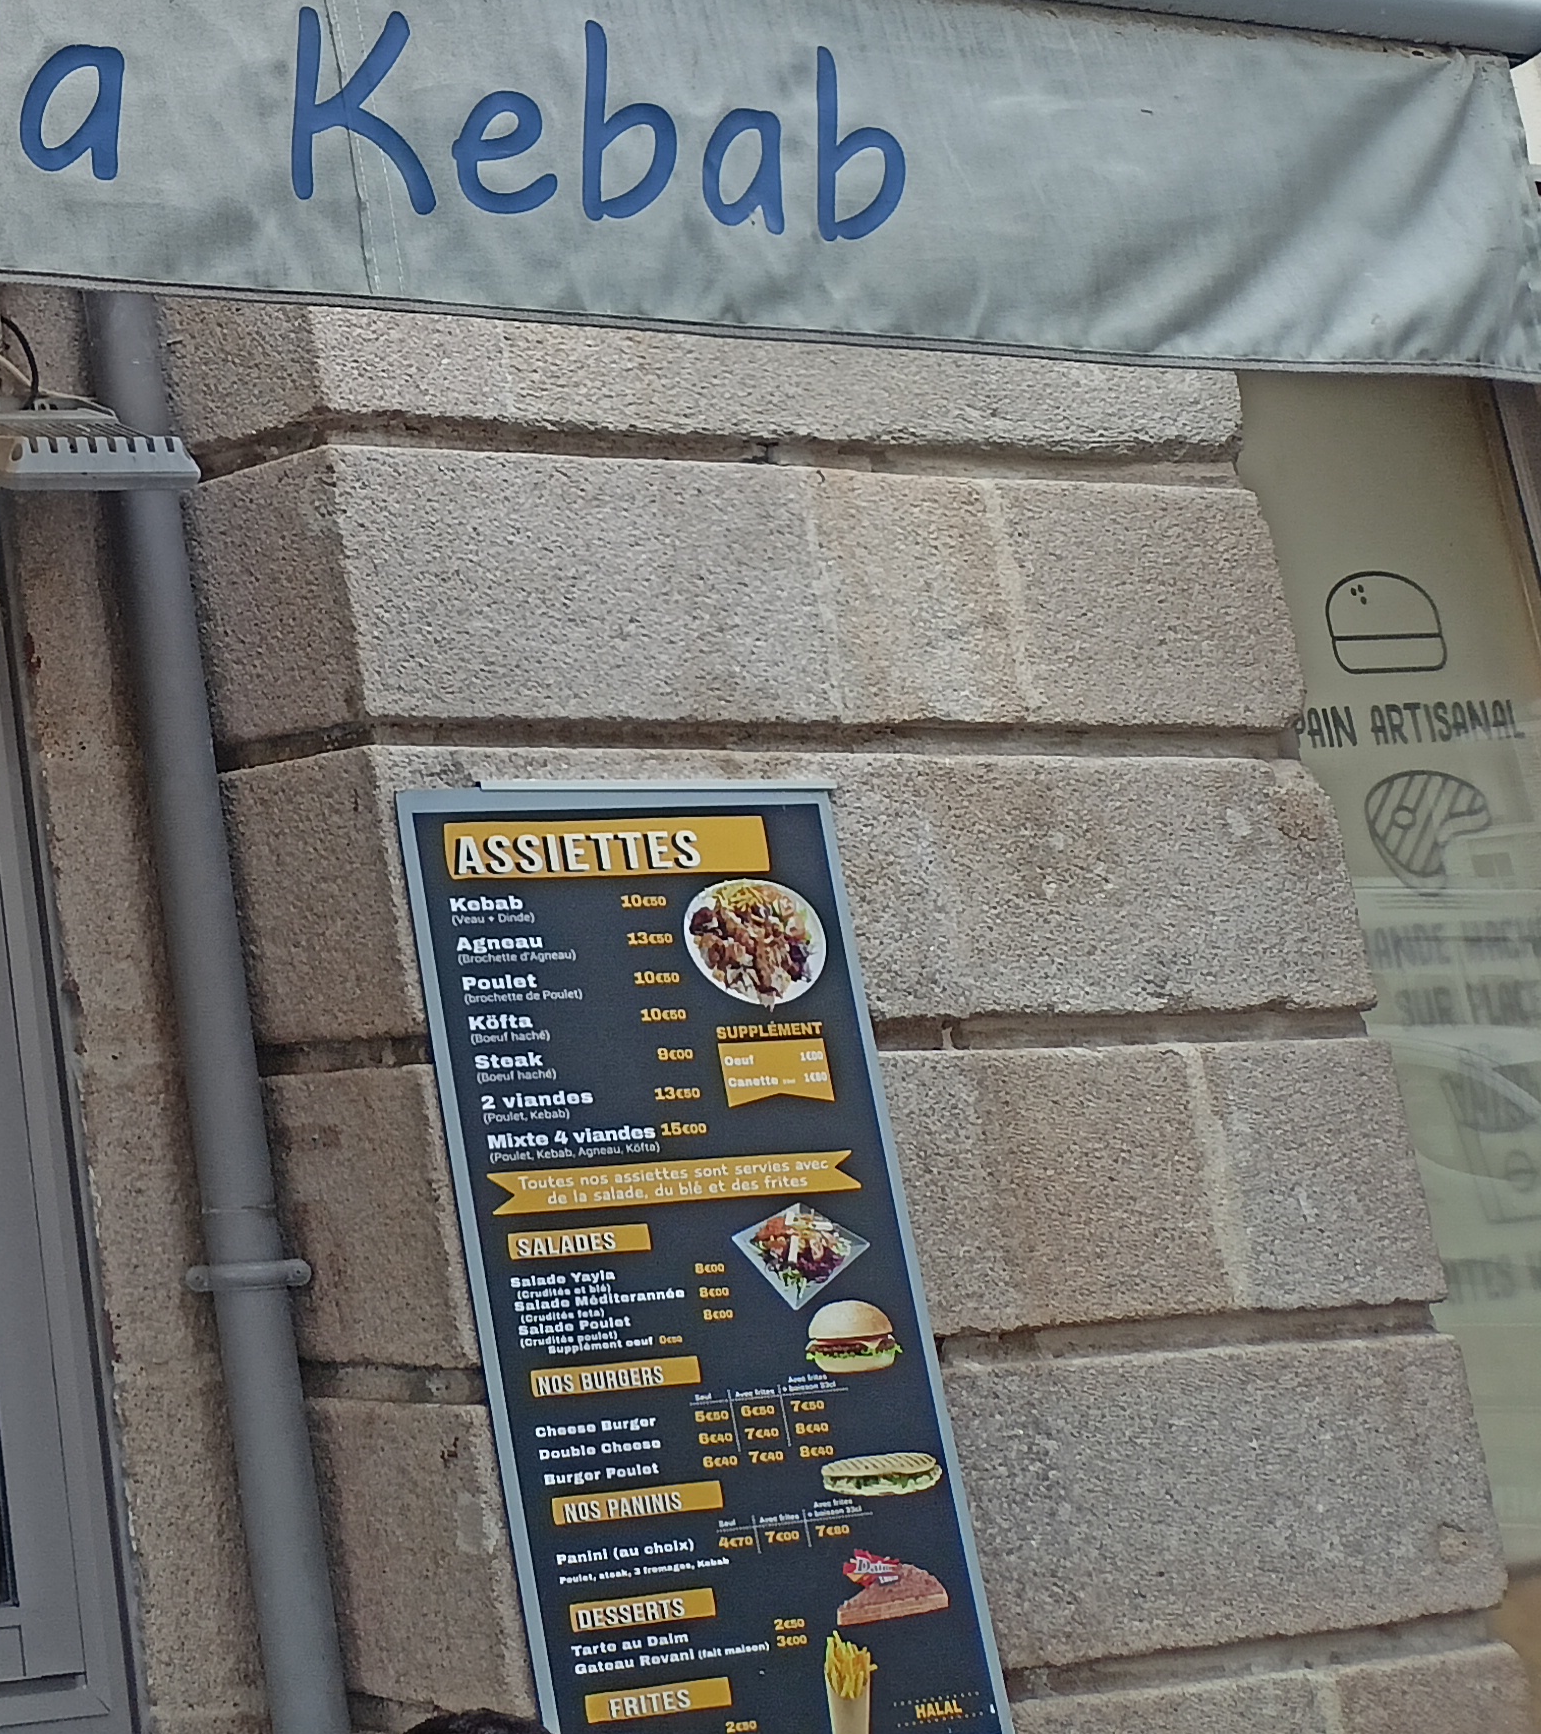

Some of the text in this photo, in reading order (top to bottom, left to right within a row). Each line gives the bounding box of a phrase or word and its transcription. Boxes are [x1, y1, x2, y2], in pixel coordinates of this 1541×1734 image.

[289, 5, 907, 243] Kebab
[1371, 699, 1525, 746] ARTISANAL
[455, 830, 701, 875] ASSIETTES
[449, 895, 667, 912] Kebab 10€50
[457, 932, 673, 953] Agneau 13€50
[458, 953, 517, 965] (Brochette
[462, 972, 680, 991] Poulet 10€50
[469, 1008, 687, 1031] Köfta 10€50
[716, 1021, 823, 1039] SUPPLÉMENT
[471, 1029, 550, 1044] (Boeuf haché)
[475, 1052, 543, 1069] Steak
[724, 1055, 754, 1067] Oeuf
[728, 1074, 779, 1089] Canette
[481, 1087, 701, 1110] 2 viandes 13€50
[483, 1108, 570, 1125] (Poulet, Kebab)
[488, 1122, 707, 1150] Mixte 4 viandes 15€00
[490, 1142, 660, 1164] (Poulet, Kebab, Agneau, Köfta)
[518, 1158, 829, 1190] Toutes nos assiettes sont servies avec
[548, 1174, 808, 1205] de la salade, du blé et des frites
[517, 1232, 617, 1257] SALADES
[510, 1270, 616, 1288] Salade Yayla
[537, 1366, 664, 1395] NOS BURGERS
[535, 1416, 657, 1438] Cheese Burger
[564, 1491, 683, 1523] NOS PANINIS
[577, 1597, 686, 1629] DESSERTS
[571, 1643, 617, 1657] Tarte
[622, 1640, 642, 1650] au
[647, 1632, 689, 1646] Daim
[609, 1689, 692, 1719] FRITES
[915, 1699, 963, 1719] HALAL
